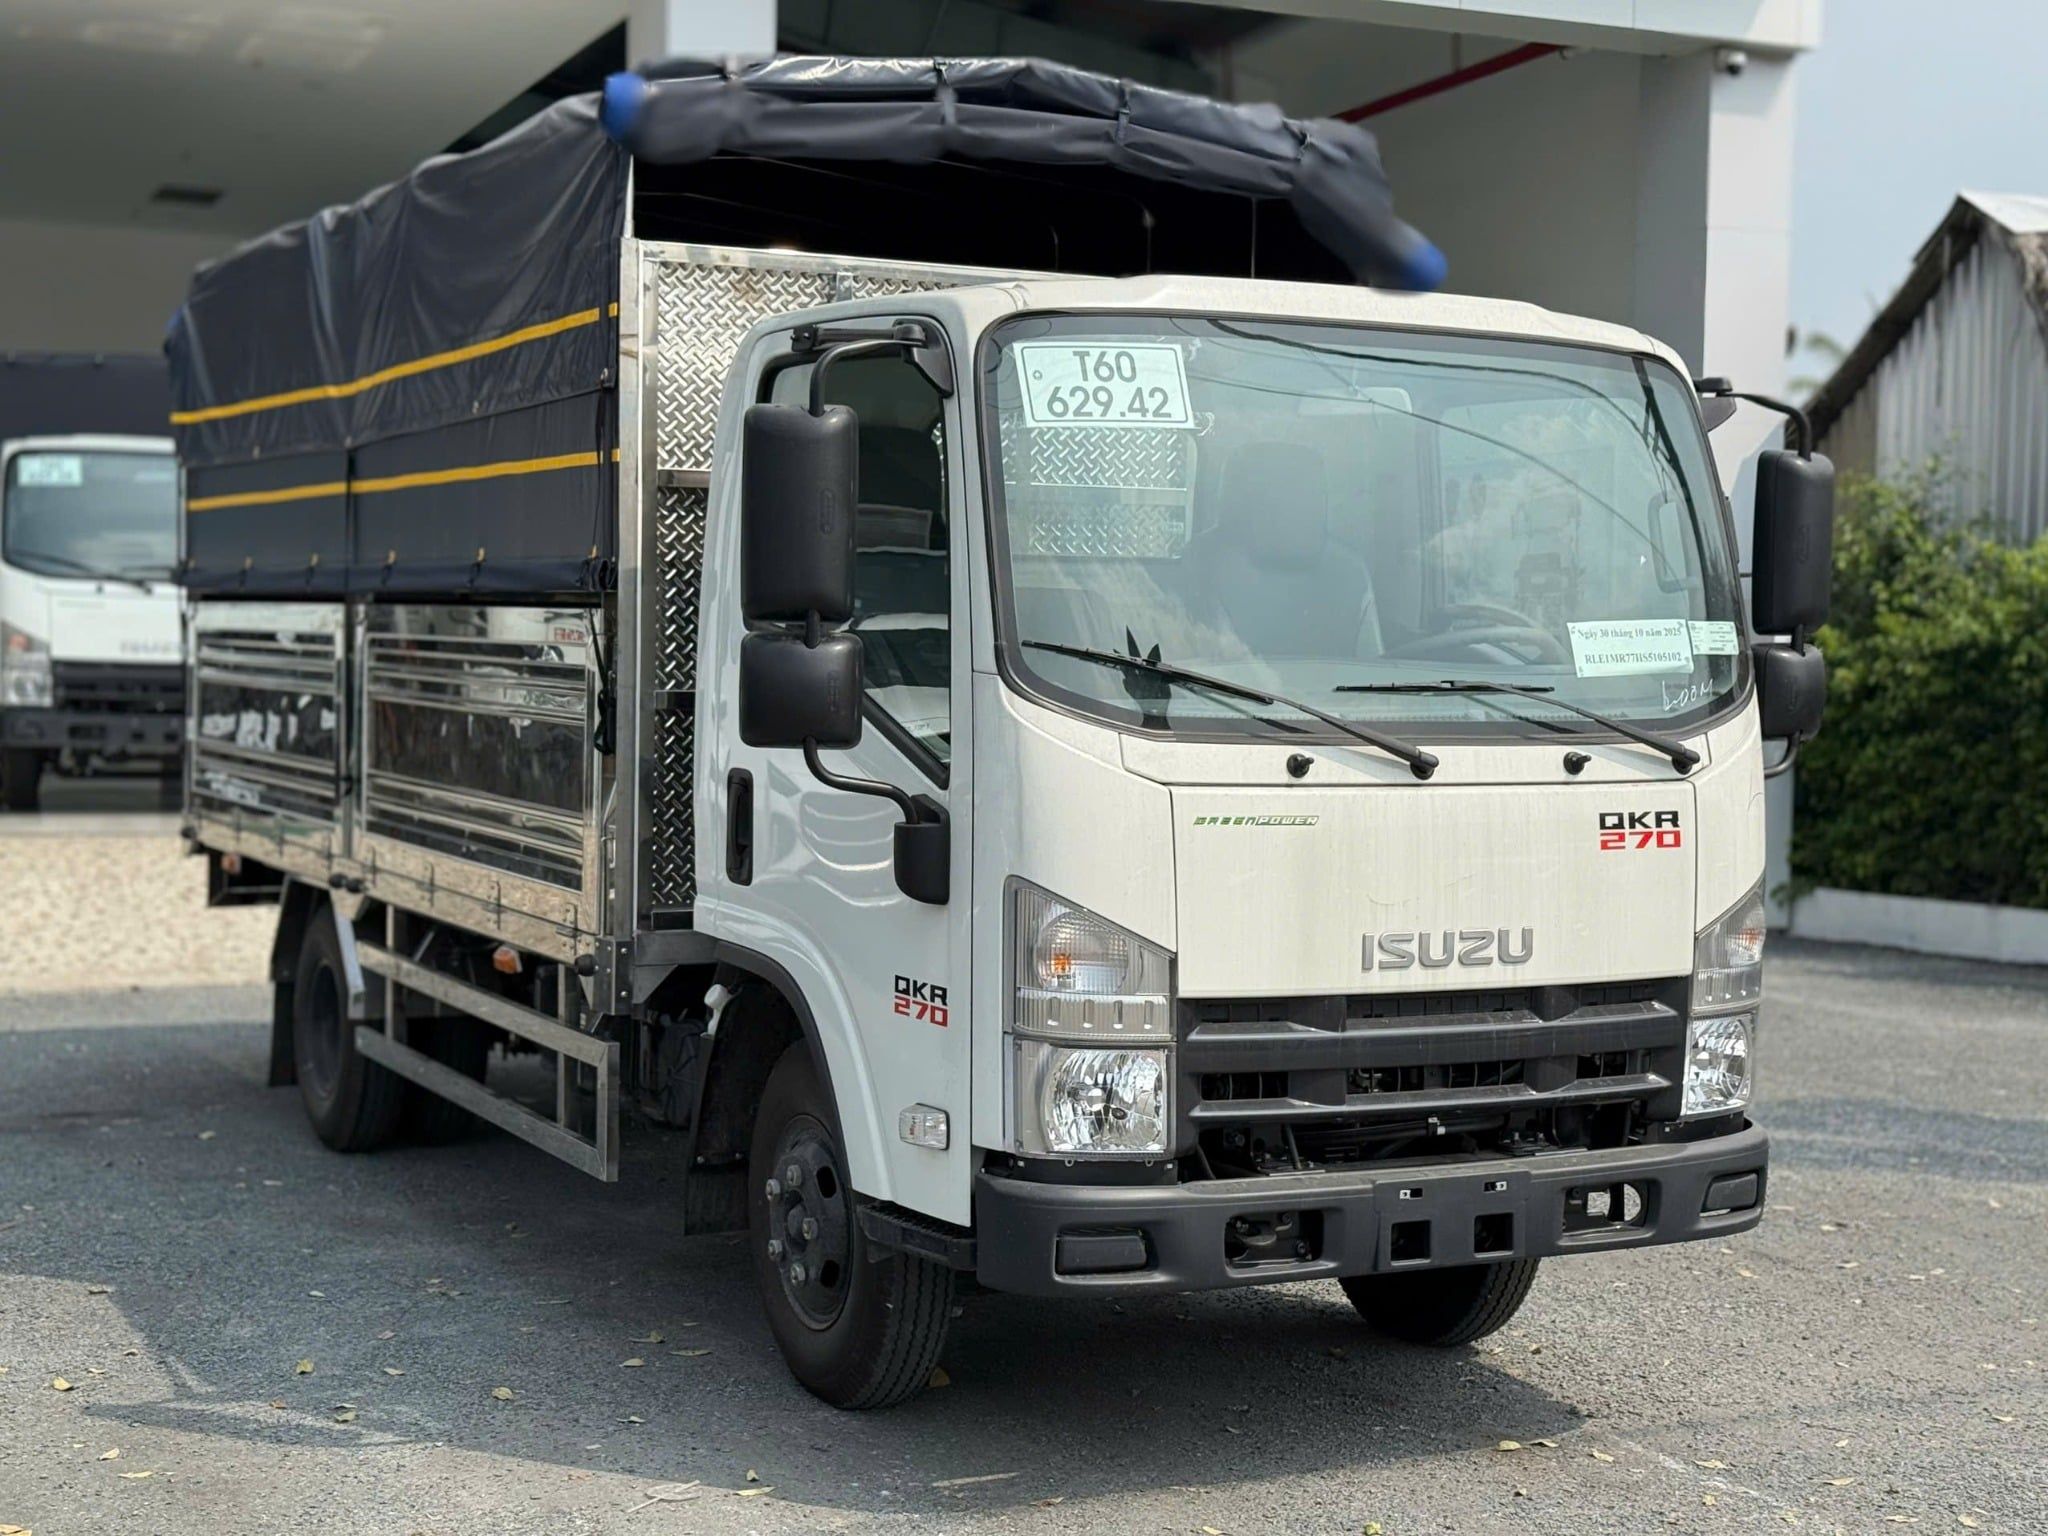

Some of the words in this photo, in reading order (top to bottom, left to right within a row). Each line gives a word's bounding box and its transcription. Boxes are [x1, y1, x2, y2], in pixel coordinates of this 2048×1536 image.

[1072, 350, 1137, 383] T60
[1047, 386, 1172, 418] 629.42
[1600, 628, 1609, 638] 30
[1635, 627, 1644, 637] 10
[1663, 627, 1682, 637] 2025
[1599, 811, 1680, 829] QKR
[1600, 831, 1681, 850] 270
[1361, 926, 1534, 971] ISUZU
[894, 974, 948, 1007] QKR
[894, 995, 948, 1027] 270
